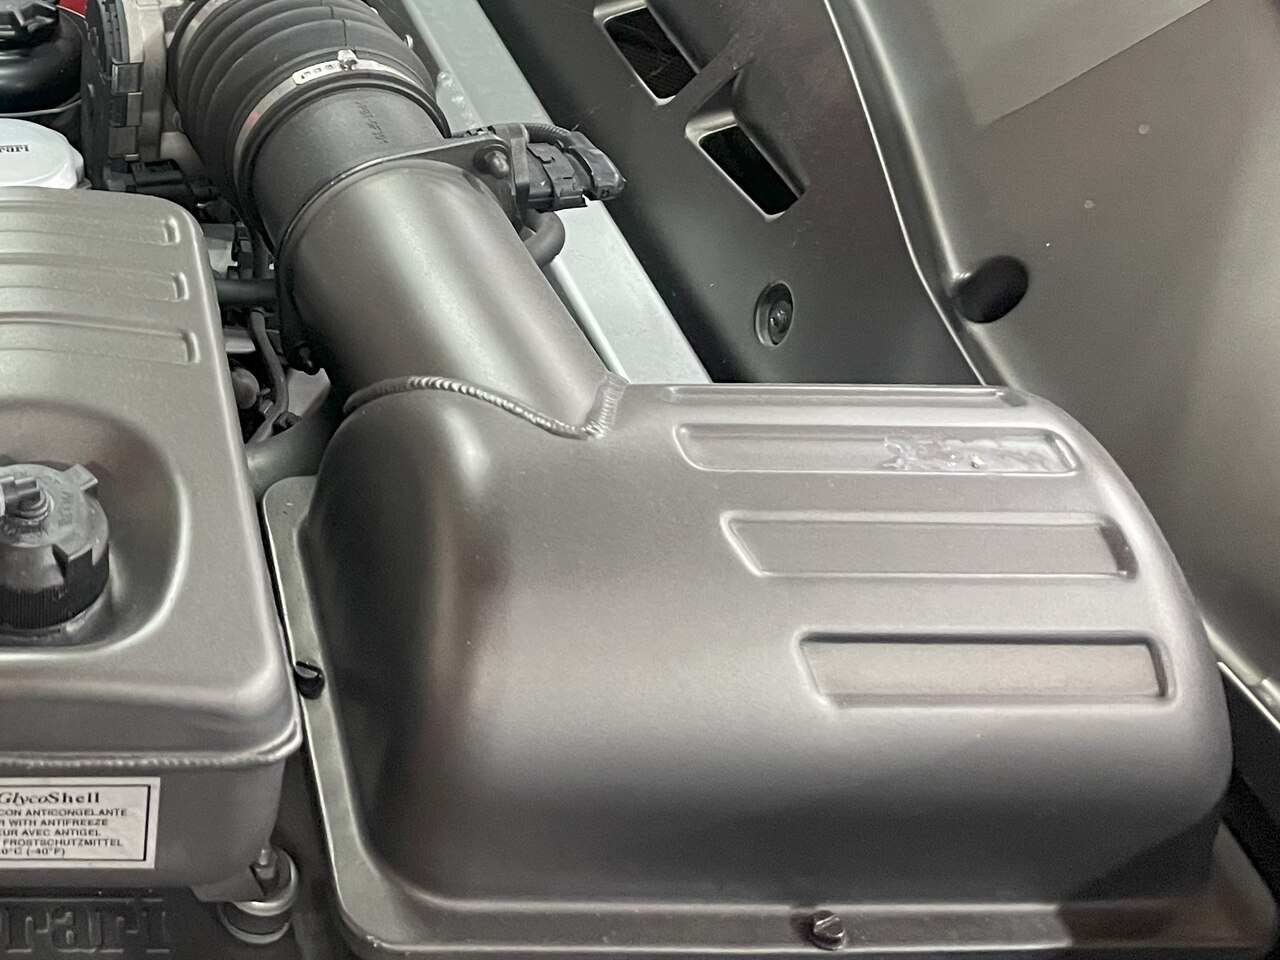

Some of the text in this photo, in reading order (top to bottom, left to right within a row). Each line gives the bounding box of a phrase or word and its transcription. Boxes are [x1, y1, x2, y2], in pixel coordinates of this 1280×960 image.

[26, 807, 127, 817] ANTICONGELANTE
[9, 818, 37, 827] WITH
[40, 818, 109, 827] ANTIFREEZE
[22, 828, 51, 837] AVEC
[54, 828, 101, 837] ANTIGEL
[3, 837, 124, 847] FROSTSCHUTZMITTEL
